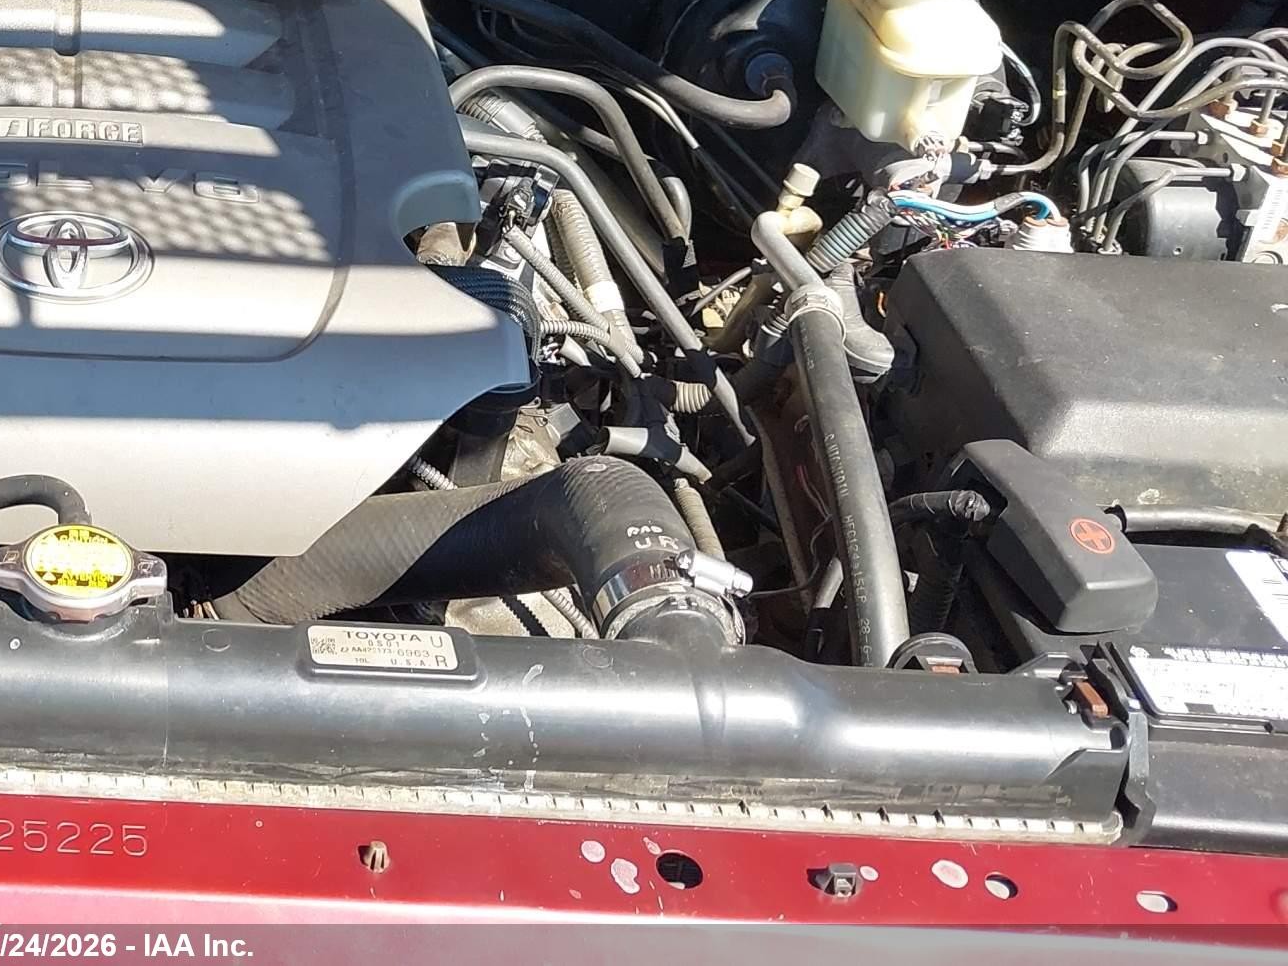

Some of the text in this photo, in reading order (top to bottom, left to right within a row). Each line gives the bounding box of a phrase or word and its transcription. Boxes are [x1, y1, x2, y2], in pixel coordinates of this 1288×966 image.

[345, 630, 421, 642] TOYOTA
[430, 635, 444, 648] U
[434, 654, 449, 667] R
